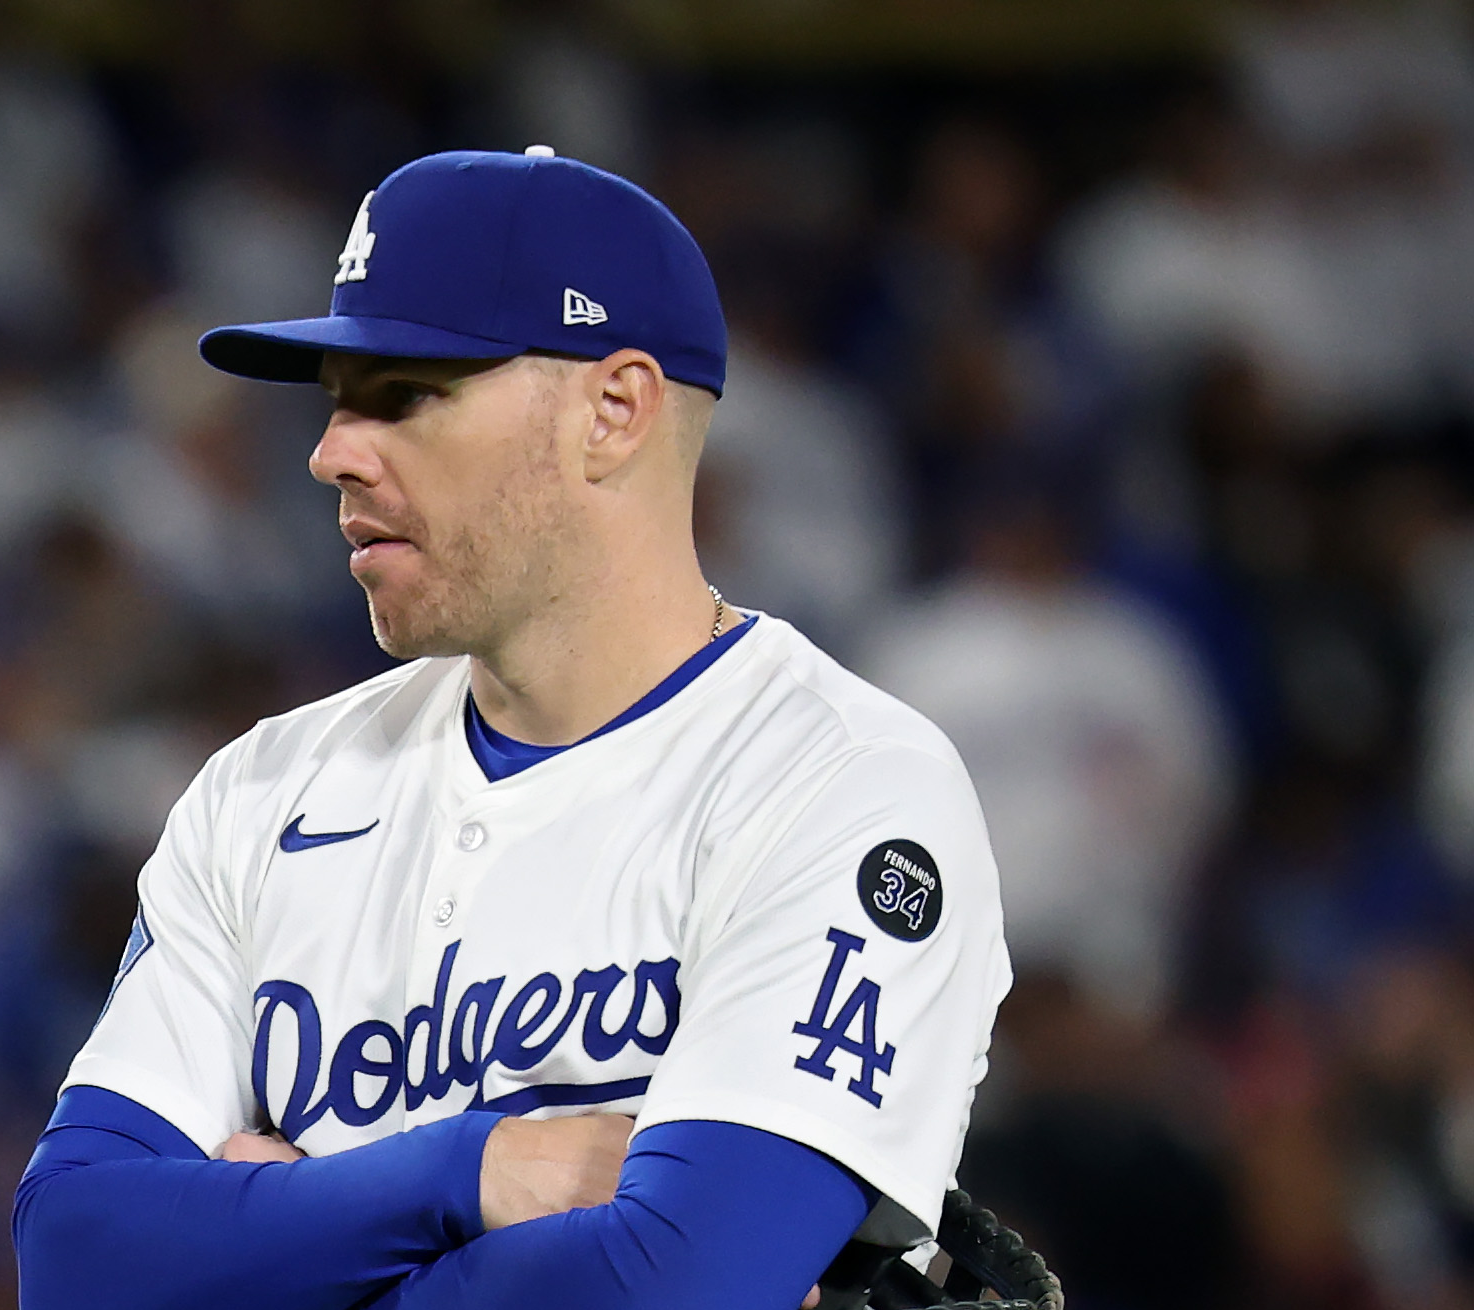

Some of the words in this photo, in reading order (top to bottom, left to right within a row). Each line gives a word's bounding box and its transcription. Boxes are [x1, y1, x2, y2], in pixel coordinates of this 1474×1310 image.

[873, 868, 928, 931] 34
[883, 849, 936, 891] FERNANDO
[251, 938, 681, 1143] Dodgers
[792, 926, 896, 1109] LA
